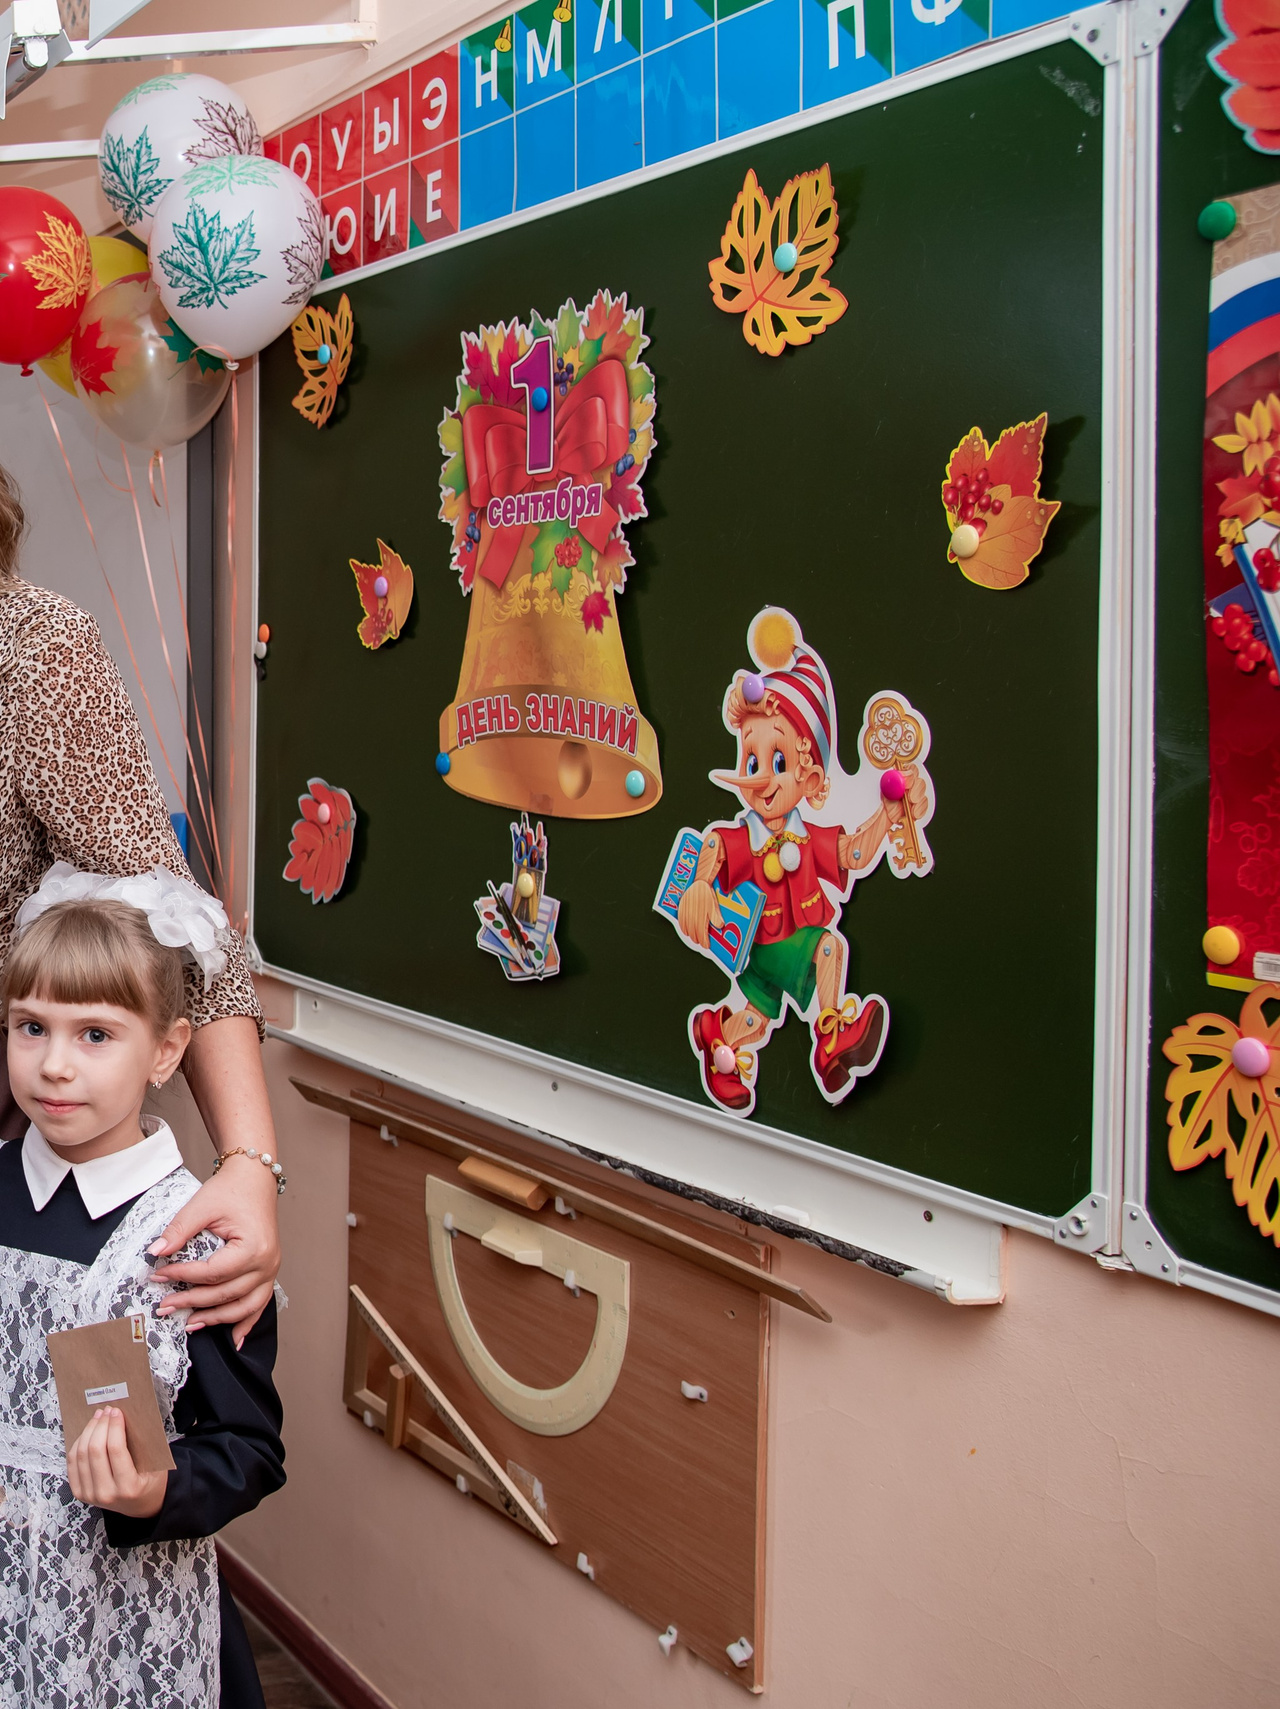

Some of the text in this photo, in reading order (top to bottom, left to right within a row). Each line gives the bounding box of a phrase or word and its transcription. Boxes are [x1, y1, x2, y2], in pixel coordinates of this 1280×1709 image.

[331, 120, 353, 171] У
[374, 97, 400, 155] Ы
[422, 77, 448, 131] Э
[475, 48, 498, 108] Н
[527, 18, 562, 85] М
[324, 169, 443, 260] Ю И Е
[510, 335, 554, 475] 1
[487, 477, 603, 528] сентября
[456, 693, 639, 758] ДЕНЬ ЗНАНИЙ
[662, 839, 699, 910] АЗБУКА
